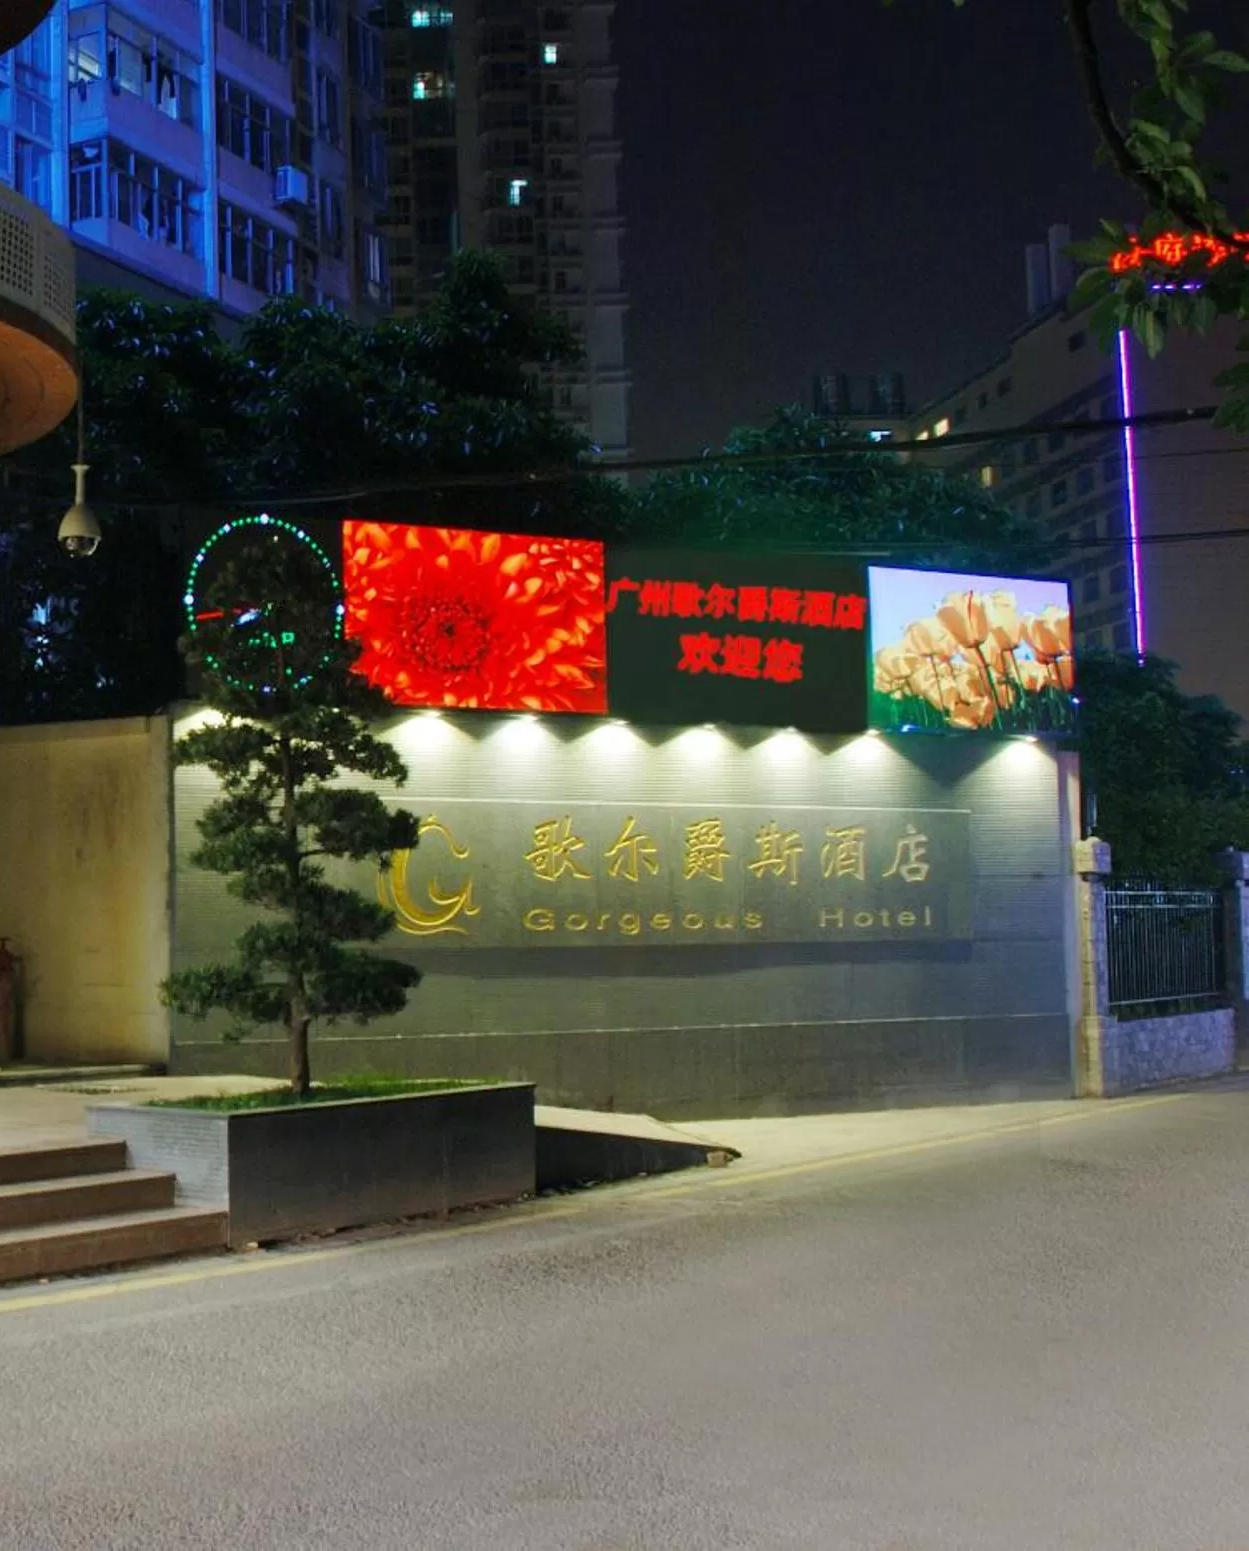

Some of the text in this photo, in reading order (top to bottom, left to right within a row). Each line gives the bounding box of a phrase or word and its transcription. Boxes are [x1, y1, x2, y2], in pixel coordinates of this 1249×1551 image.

[604, 577, 867, 630] 广州歌尔爵斯酒店
[677, 632, 804, 684] 欢迎您
[524, 815, 932, 886] 歌尔爵斯酒店
[522, 906, 932, 935] Gorgeous Hotel
